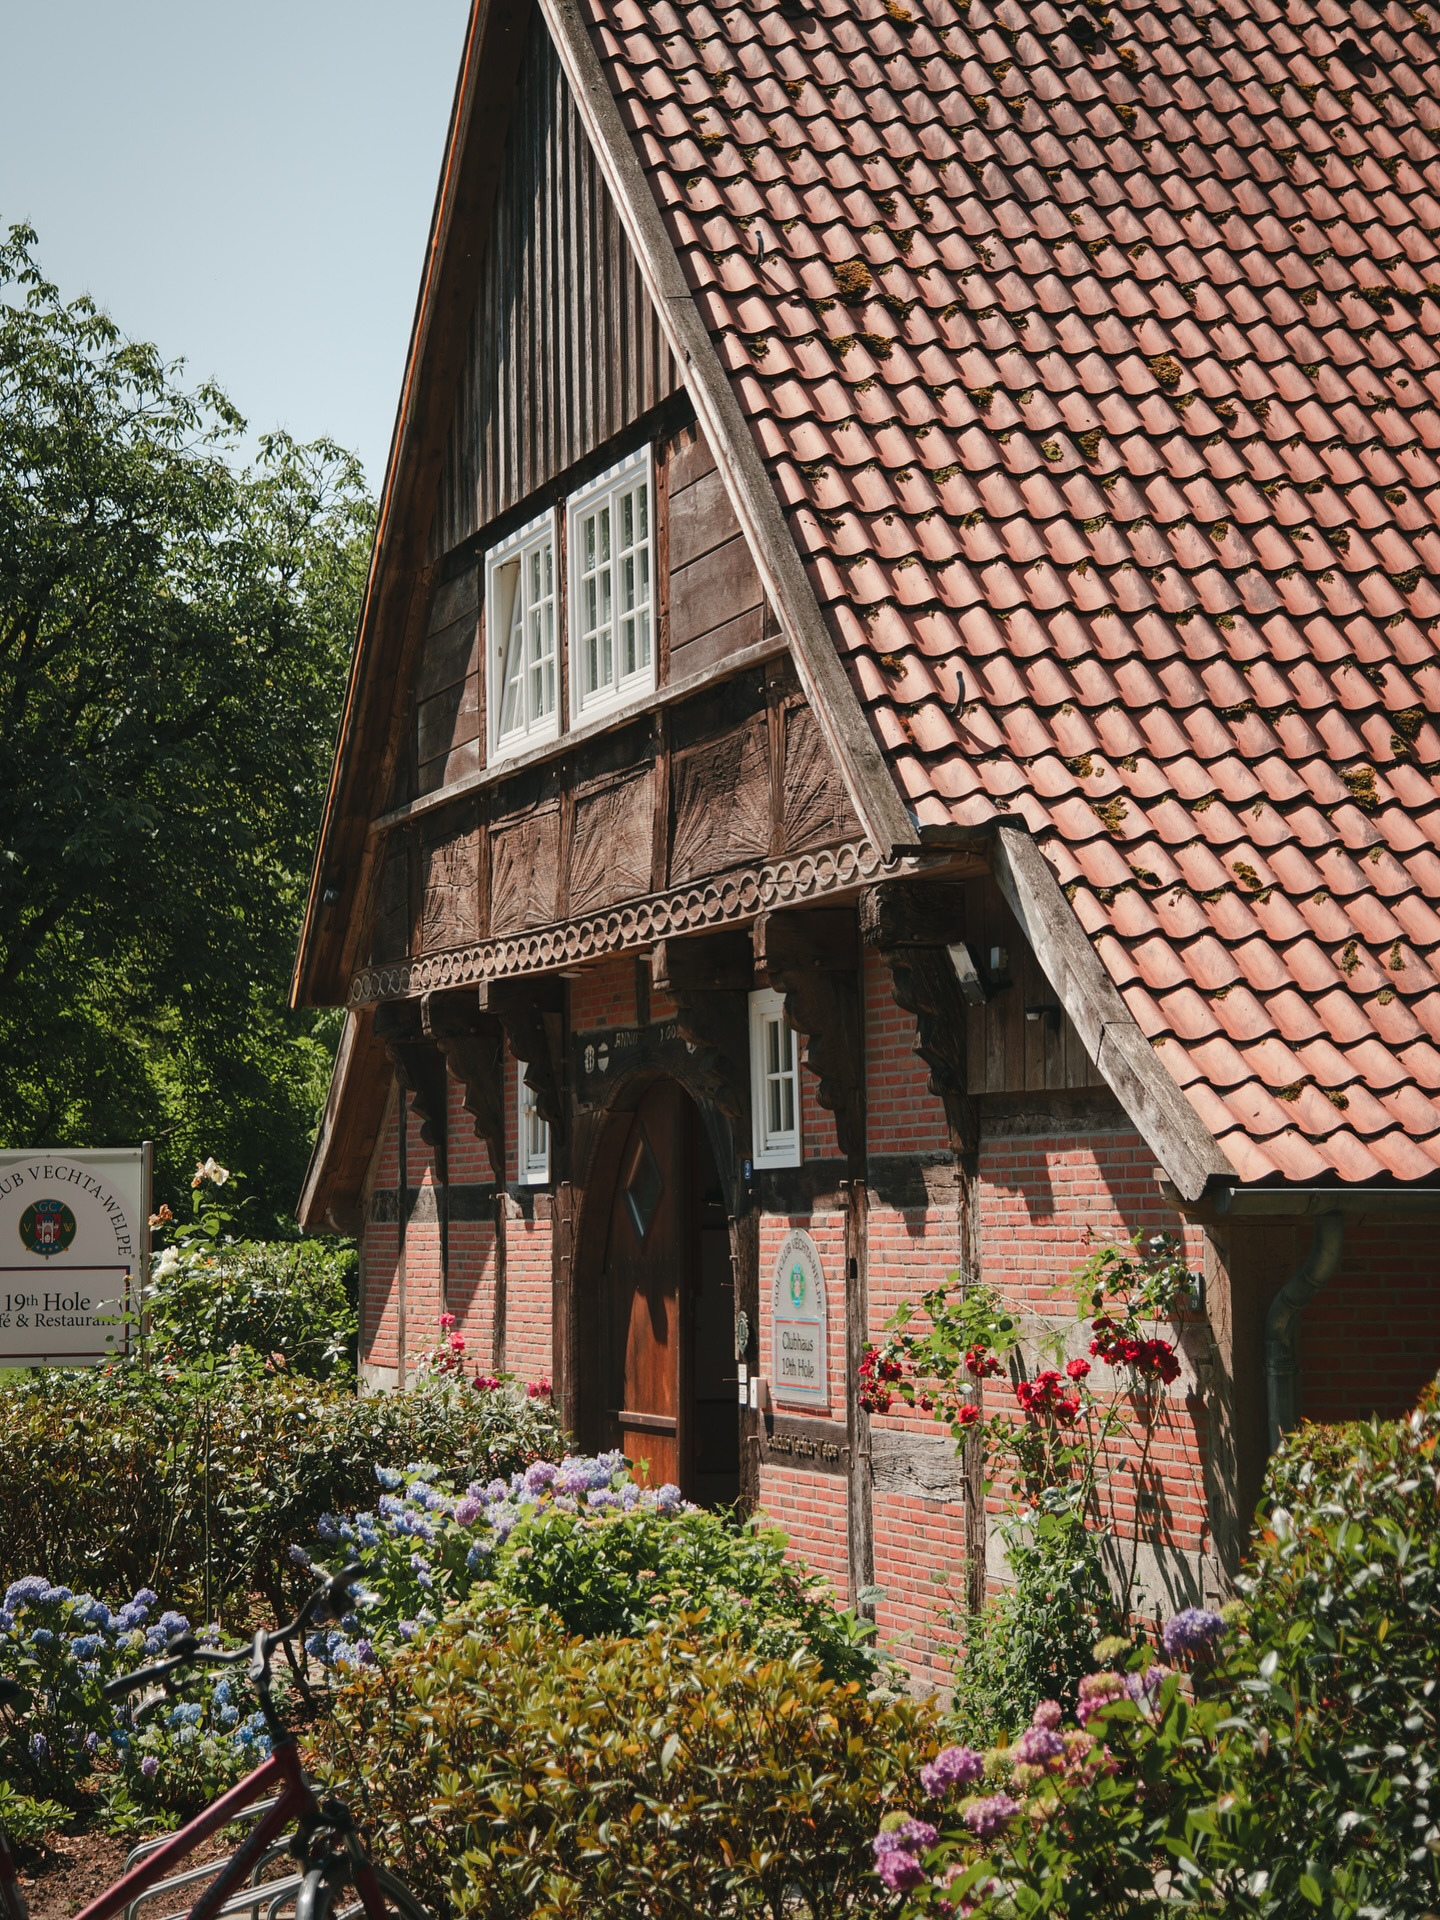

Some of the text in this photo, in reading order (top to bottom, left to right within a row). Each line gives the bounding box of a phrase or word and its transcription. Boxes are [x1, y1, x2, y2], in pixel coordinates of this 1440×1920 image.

[28, 1165, 132, 1255] VECHTA-WELPE
[38, 1202, 58, 1212] GC
[774, 1242, 792, 1307] GOLFCLUB
[4, 1291, 91, 1312] 19th Hole
[16, 1313, 30, 1328] &
[782, 1331, 814, 1352] Clubhaus
[782, 1357, 814, 1378] 19th Hole
